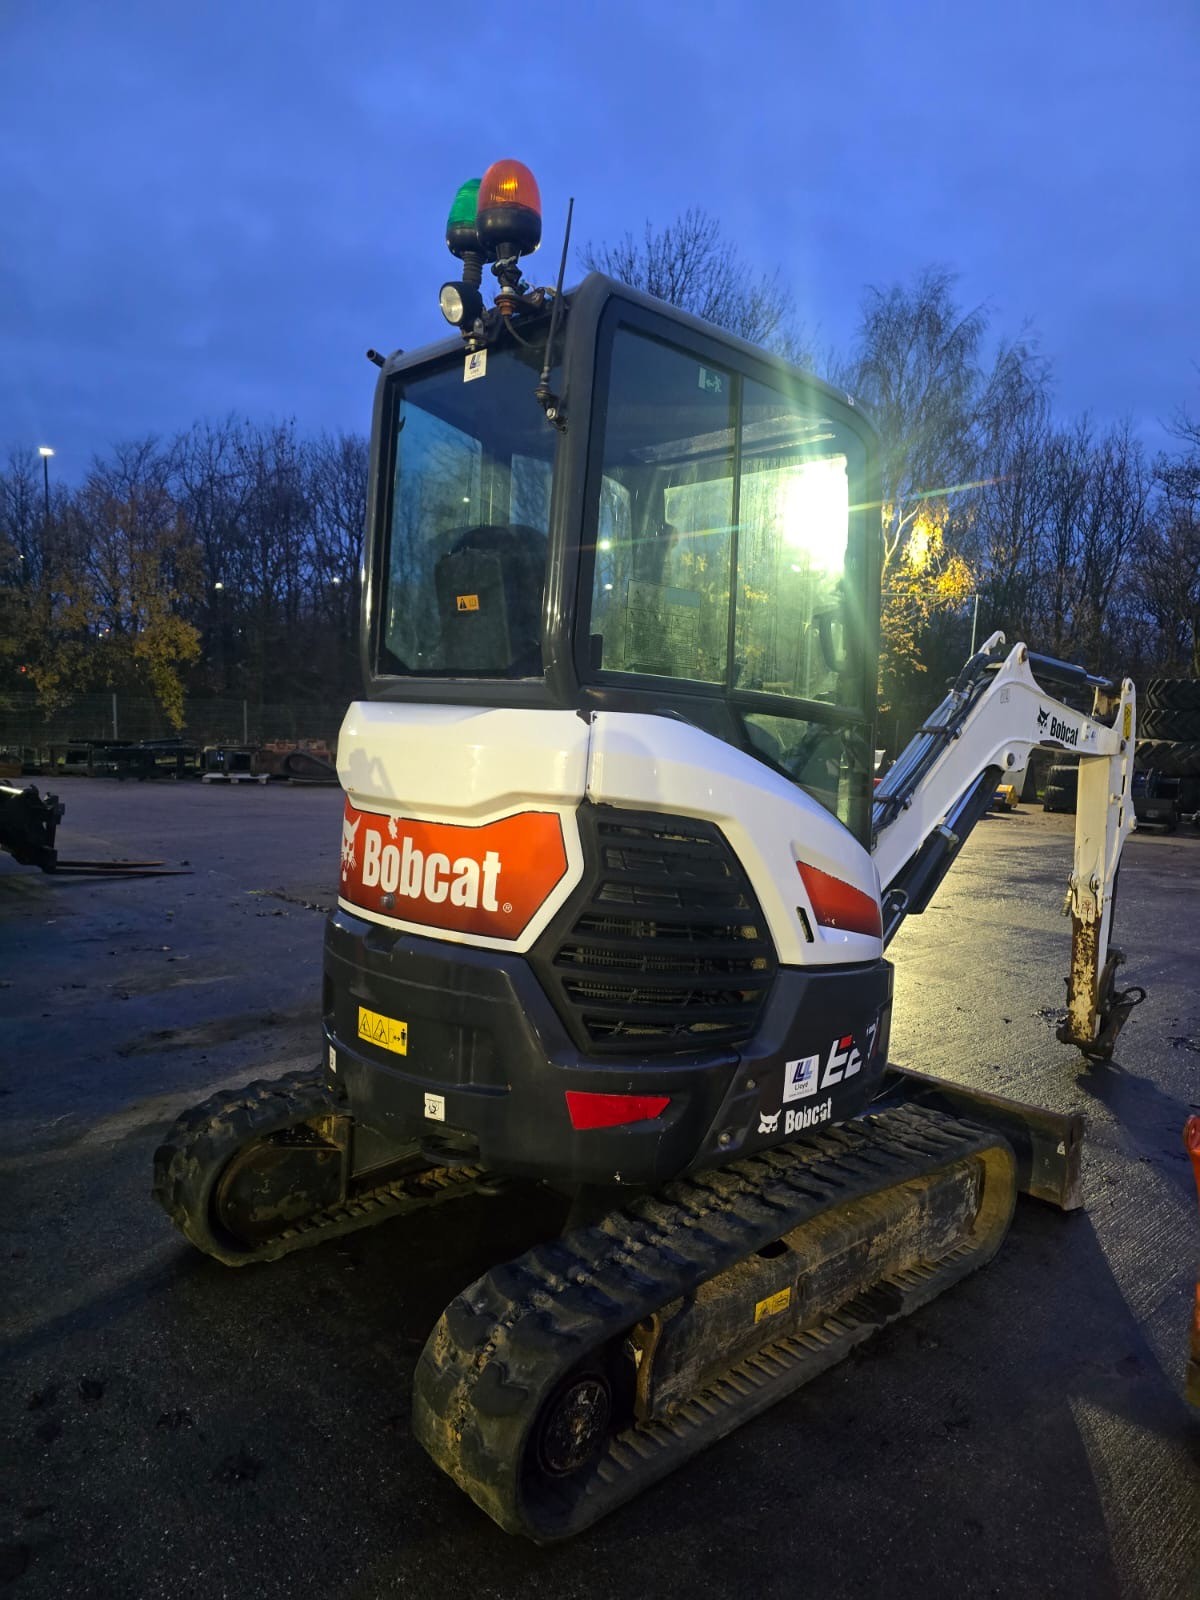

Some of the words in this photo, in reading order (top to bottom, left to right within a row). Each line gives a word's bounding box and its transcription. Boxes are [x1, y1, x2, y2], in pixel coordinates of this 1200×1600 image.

[1050, 716, 1079, 747] Bobcat
[362, 829, 502, 912] Bobcat
[784, 1097, 833, 1135] Bobcat
